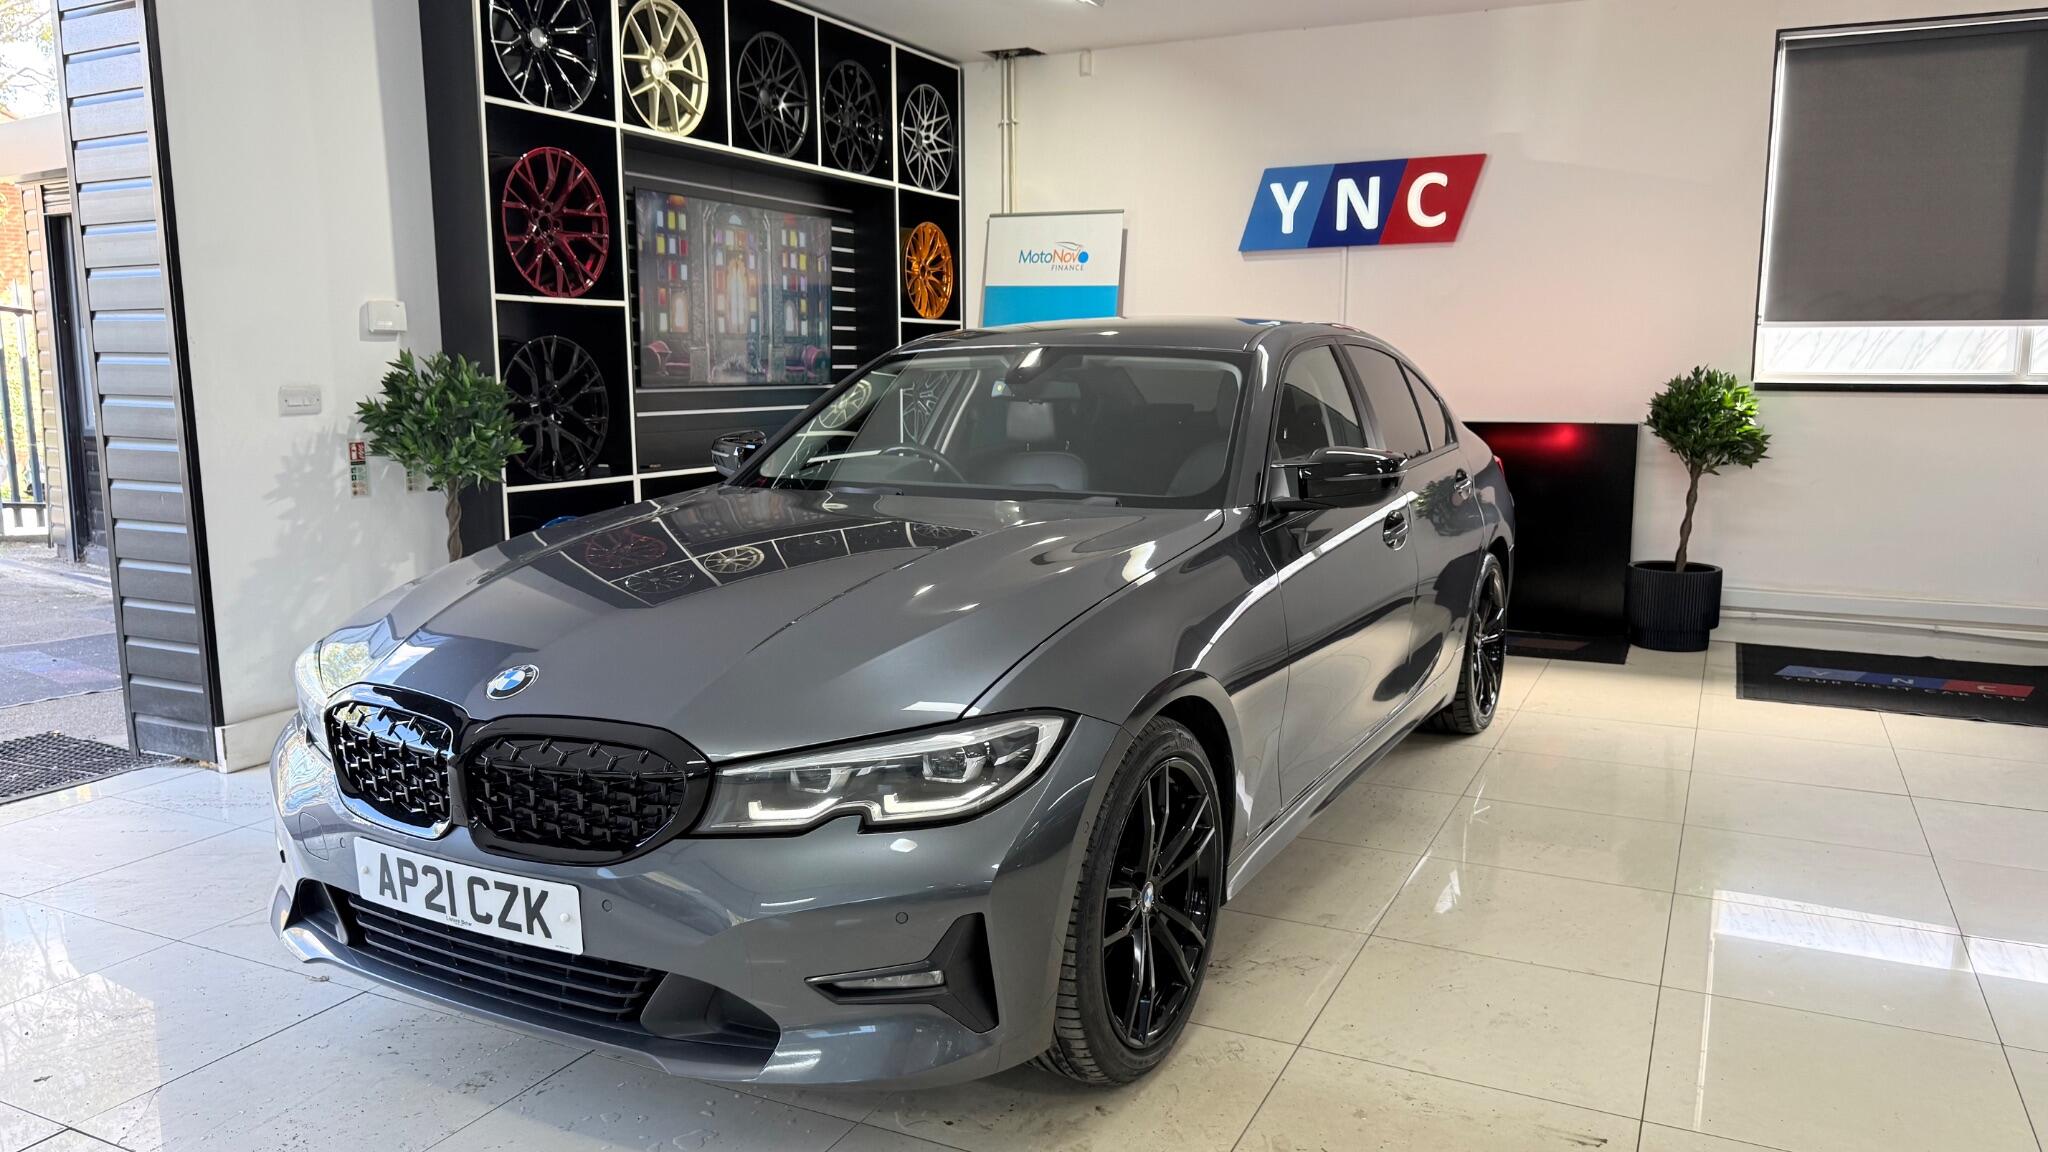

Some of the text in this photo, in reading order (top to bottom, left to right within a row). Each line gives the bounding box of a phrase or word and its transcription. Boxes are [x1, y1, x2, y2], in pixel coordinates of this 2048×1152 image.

[1270, 172, 1448, 234] YNC
[1018, 248, 1089, 265] MotoNovo
[379, 852, 552, 939] AP21 CZK
